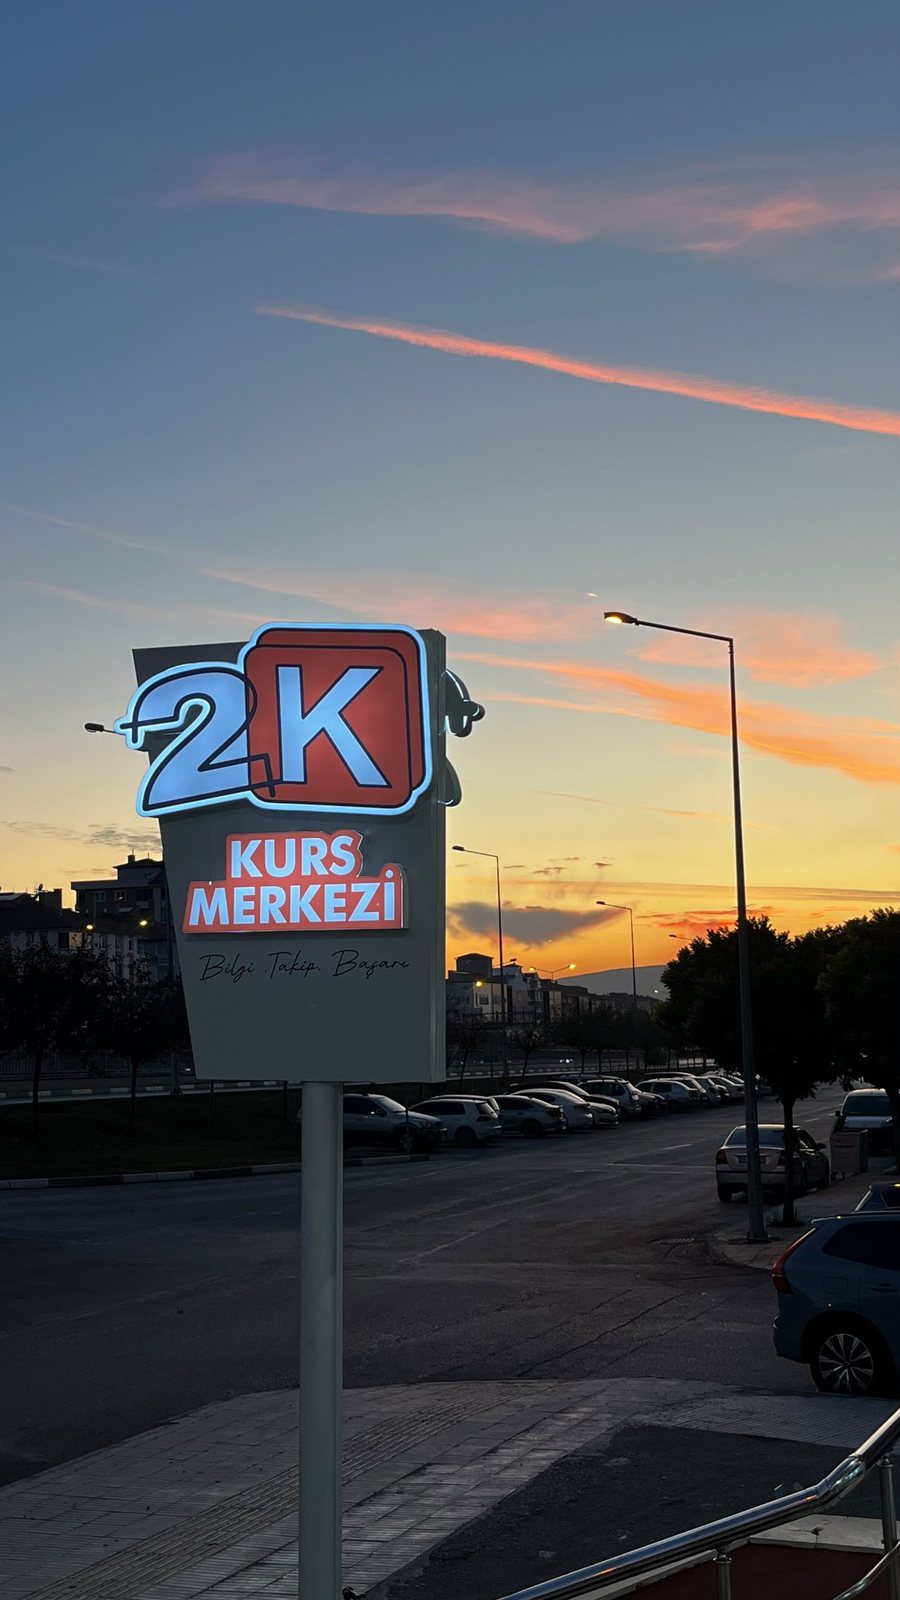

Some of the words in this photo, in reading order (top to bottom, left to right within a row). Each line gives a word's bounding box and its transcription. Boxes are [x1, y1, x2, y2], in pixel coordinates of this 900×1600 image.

[120, 664, 393, 810] 2K
[231, 835, 356, 878] KURS
[188, 869, 396, 926] MERKEZİ
[199, 953, 255, 983] Bilgi
[331, 949, 411, 979] Başarı
